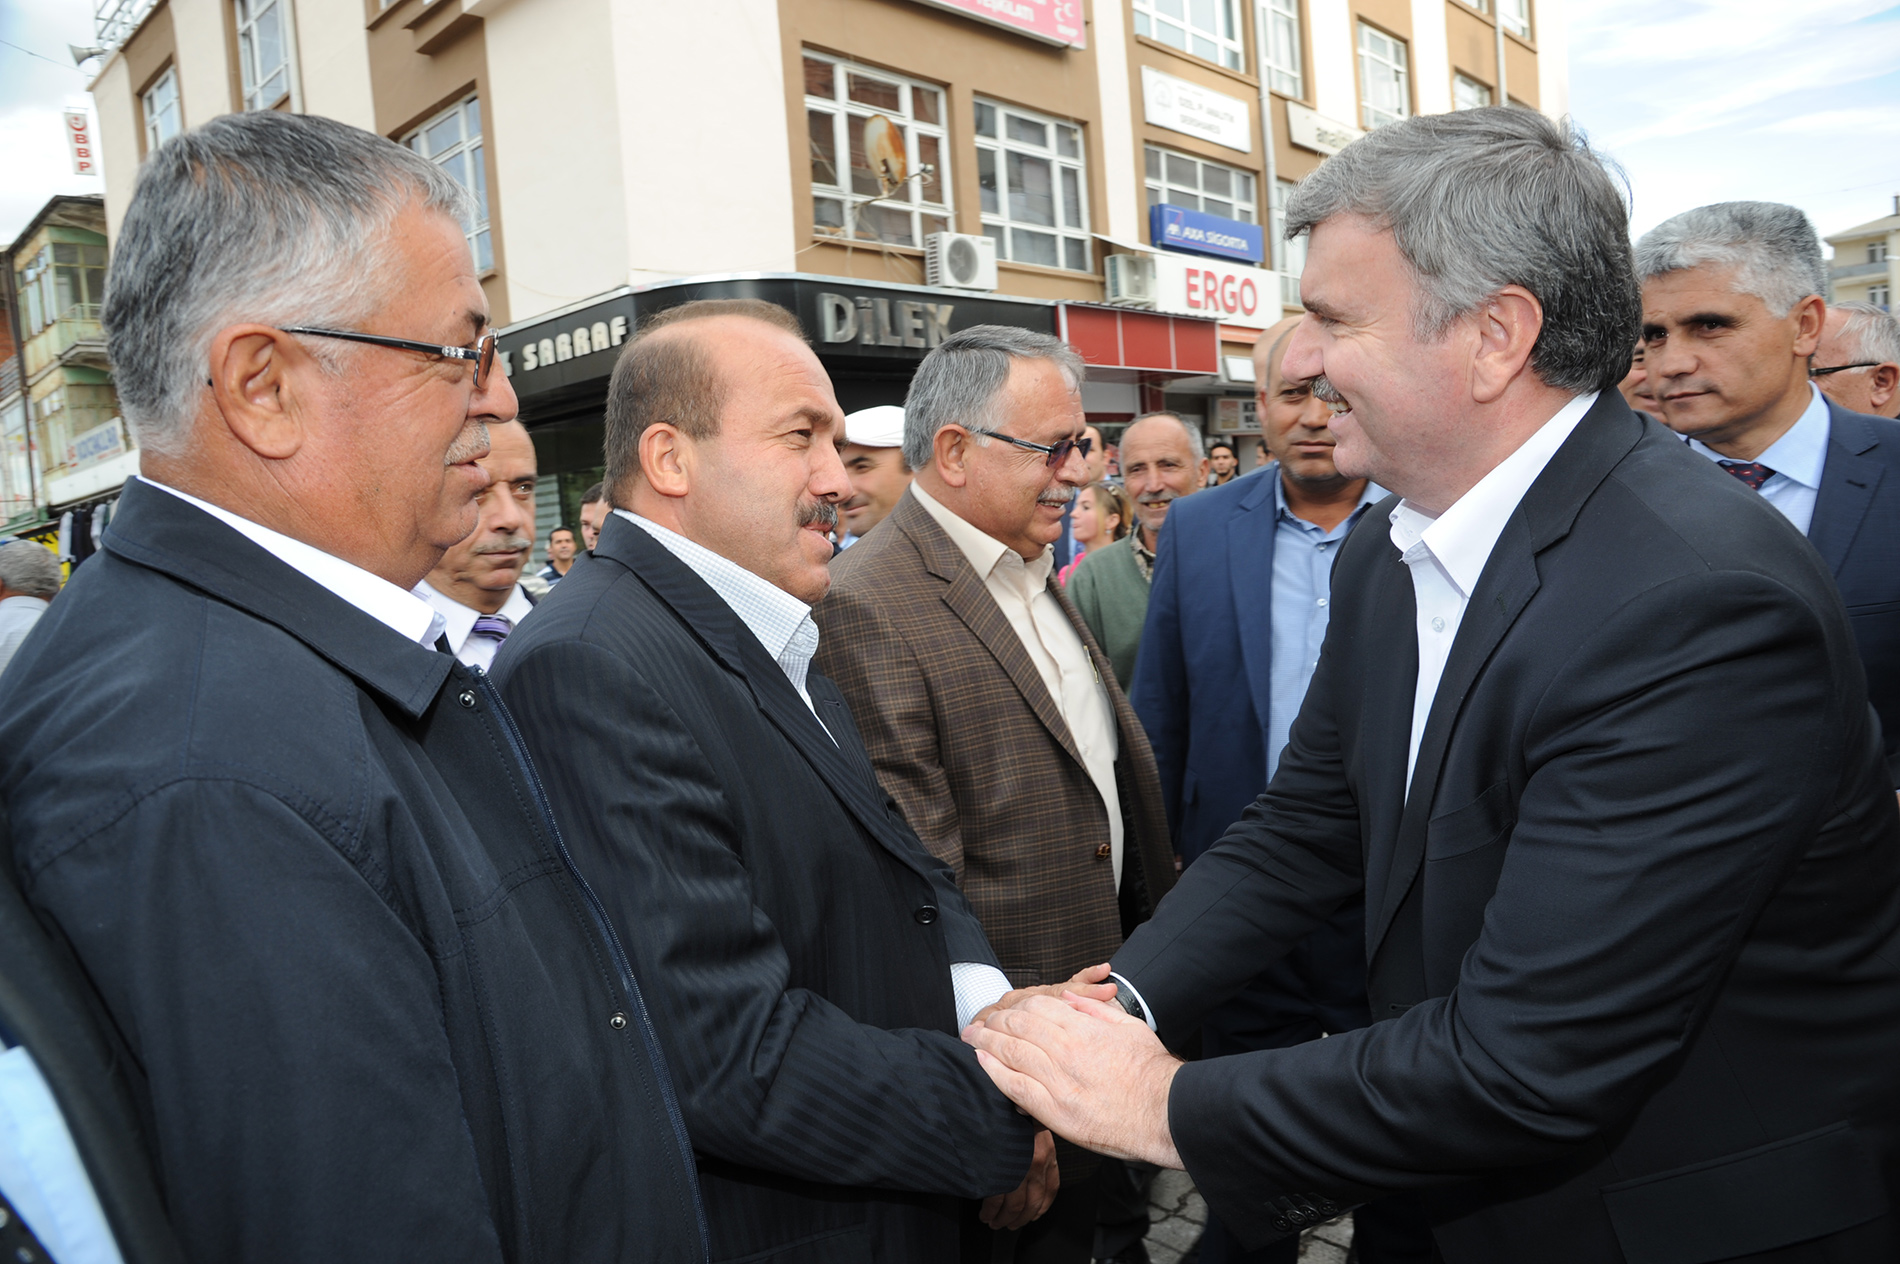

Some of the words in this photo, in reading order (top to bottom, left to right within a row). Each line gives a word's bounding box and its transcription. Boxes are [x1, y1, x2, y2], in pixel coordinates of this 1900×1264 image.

[73, 133, 92, 171] BBP
[1182, 226, 1206, 243] AXA
[1185, 267, 1258, 316] ERGO
[522, 315, 627, 372] SARRAF
